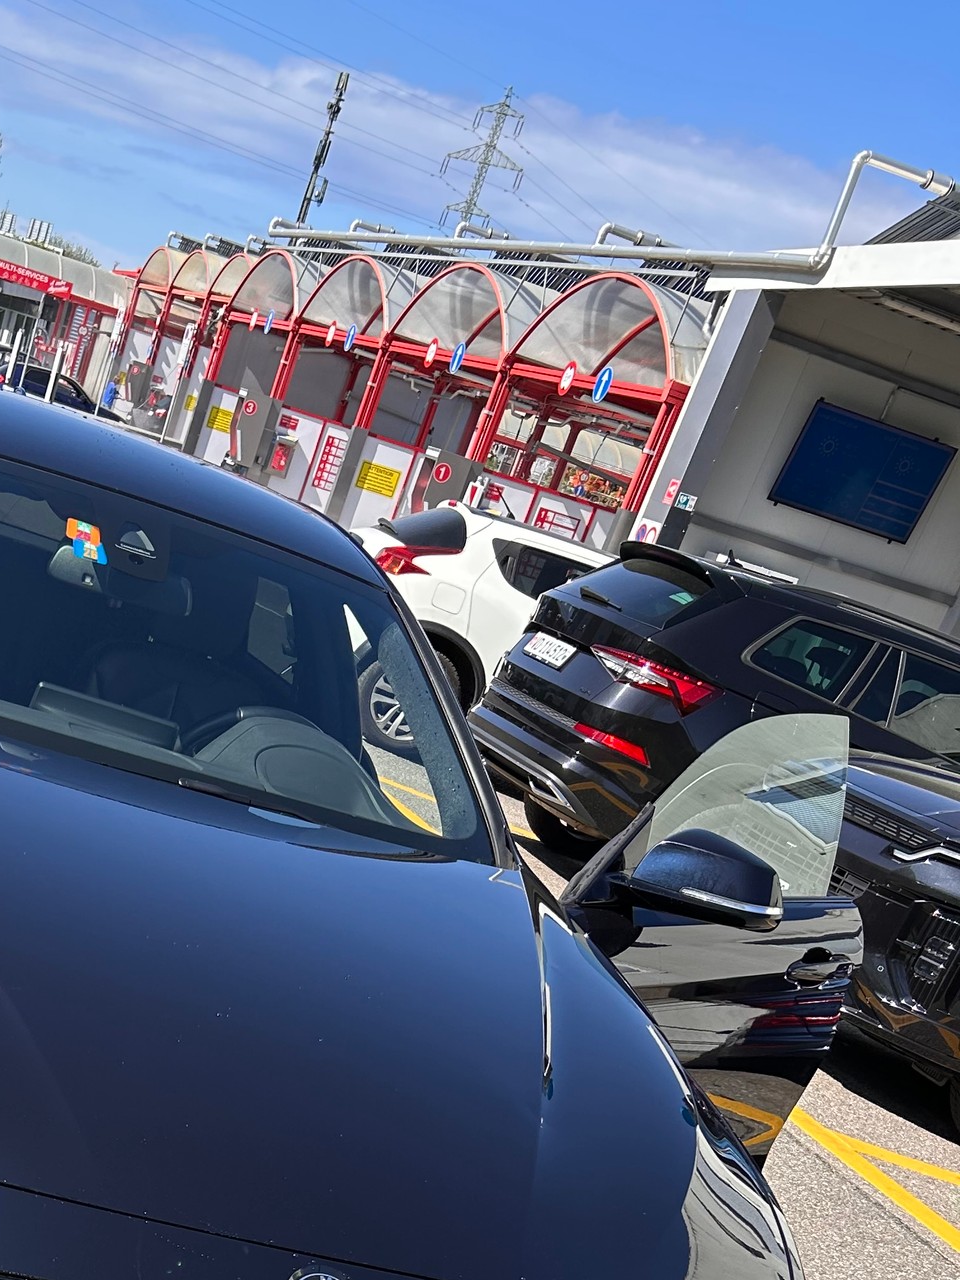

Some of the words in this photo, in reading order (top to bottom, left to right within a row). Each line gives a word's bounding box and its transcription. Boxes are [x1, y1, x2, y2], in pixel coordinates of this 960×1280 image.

[246, 402, 254, 413] 3
[368, 465, 394, 478] ATTENTION
[439, 466, 447, 479] 1
[75, 529, 92, 542] 25
[83, 547, 99, 560] 26
